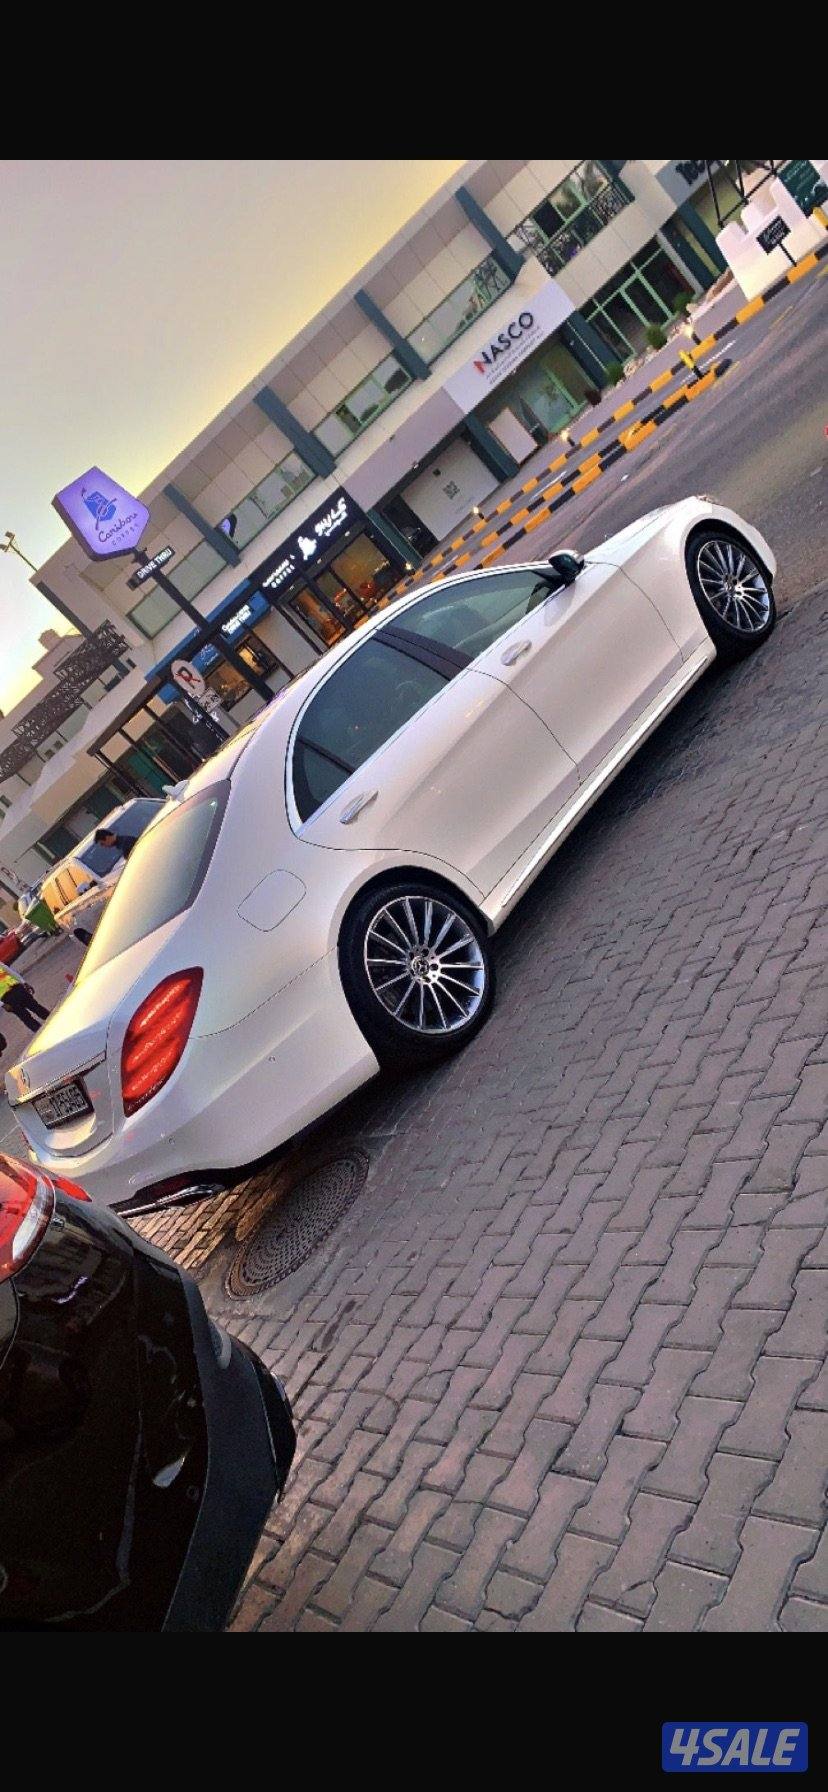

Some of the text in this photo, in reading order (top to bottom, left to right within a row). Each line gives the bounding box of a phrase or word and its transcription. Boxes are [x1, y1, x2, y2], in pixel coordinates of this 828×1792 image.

[473, 312, 534, 375] NASCO
[98, 512, 138, 543] Caribou
[136, 549, 172, 579] DRIVE THRU
